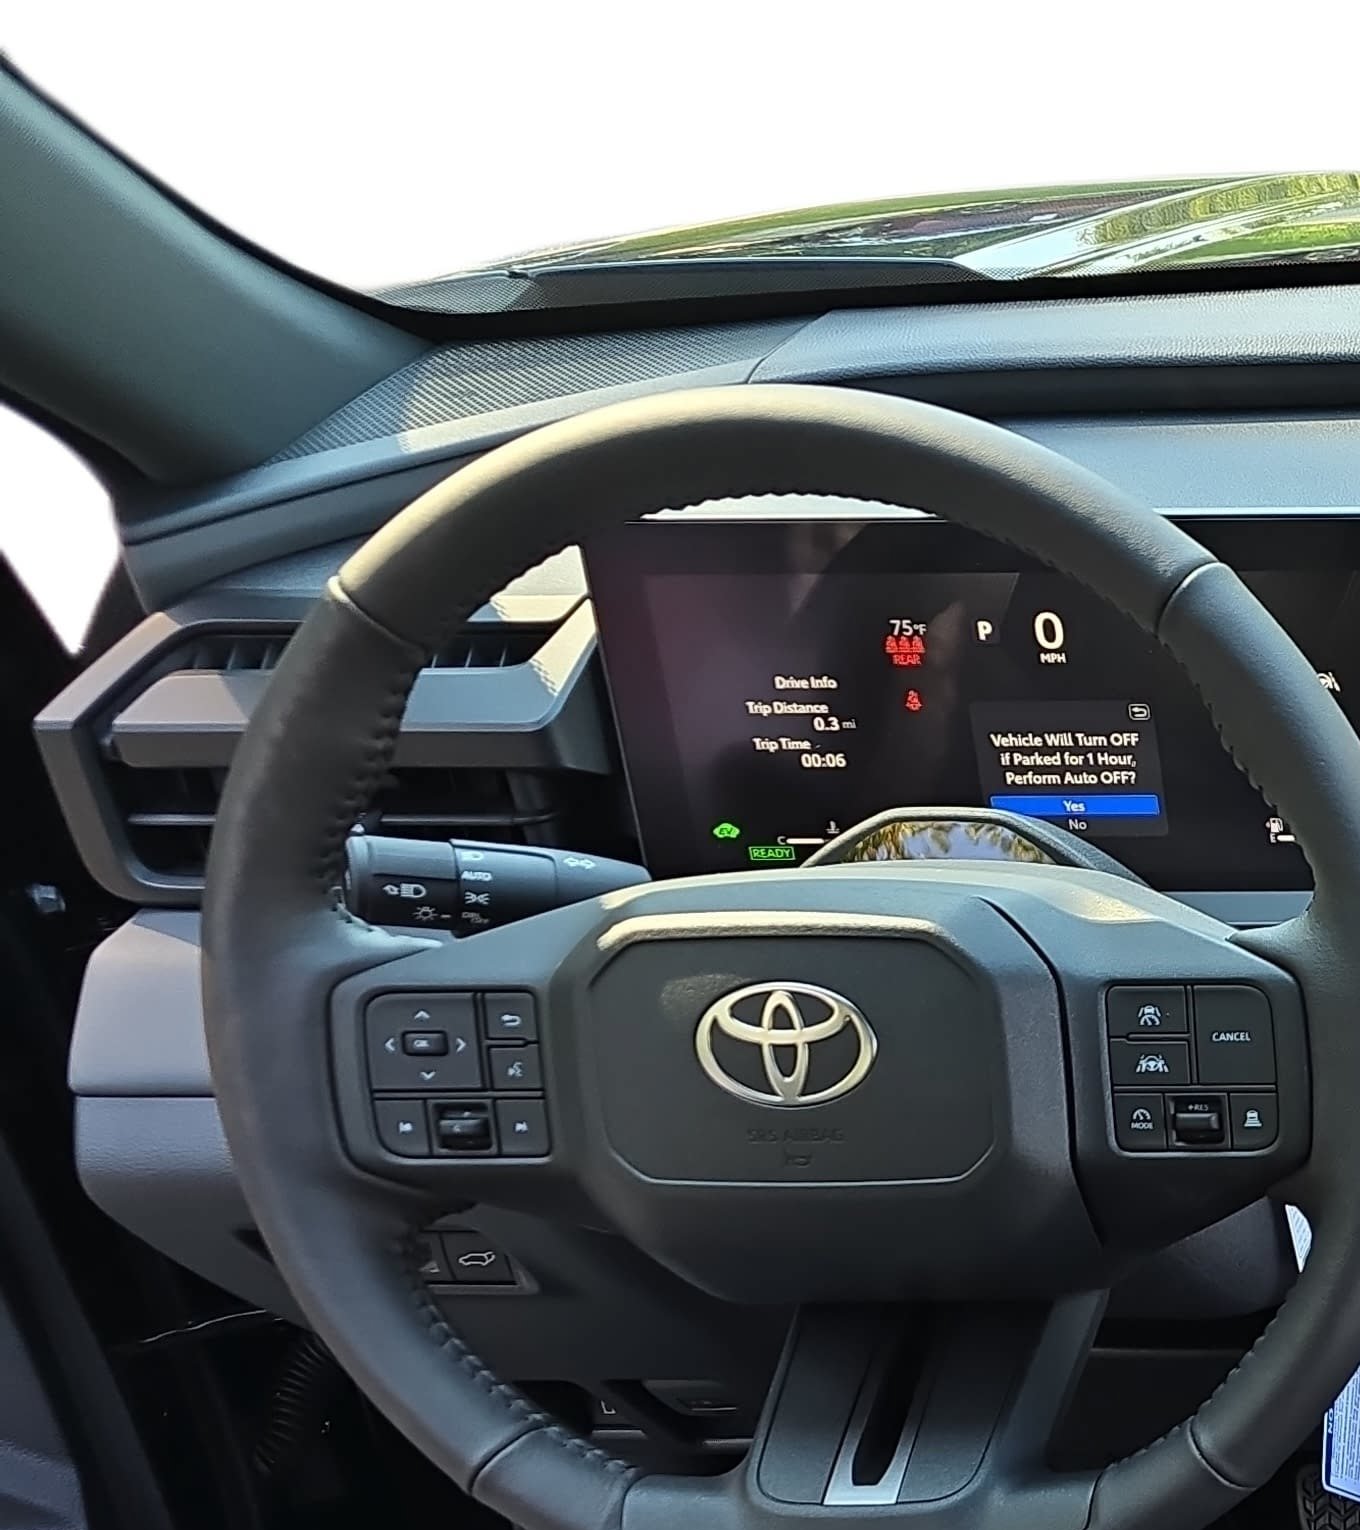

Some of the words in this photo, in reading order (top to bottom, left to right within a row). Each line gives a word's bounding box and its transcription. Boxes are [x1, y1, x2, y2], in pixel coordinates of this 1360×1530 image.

[976, 620, 993, 641] P
[1033, 611, 1064, 650] 0
[893, 654, 922, 665] REAR
[1040, 653, 1067, 664] MPH
[774, 676, 809, 689] Drive
[810, 676, 838, 689] Info
[745, 701, 772, 716] Trip
[773, 701, 829, 714] Distance
[813, 717, 840, 731] 0.3
[842, 719, 857, 729] mi
[753, 738, 780, 752] Trip
[780, 738, 812, 750] Time
[990, 733, 1043, 747] Vehicle
[1044, 733, 1074, 747] Will
[1074, 733, 1108, 747] Turn
[1110, 733, 1139, 746] OFF
[801, 754, 847, 768] 00:06
[1000, 752, 1012, 766] if
[1013, 752, 1061, 766] Parked
[1063, 752, 1085, 766] for
[1086, 753, 1094, 765] 1
[1097, 753, 1137, 767] Hour,
[1005, 772, 1060, 785] Perform
[1063, 772, 1098, 785] Auto
[1100, 771, 1136, 785] OFF?
[1063, 800, 1085, 812] Yes
[1068, 819, 1088, 831] No
[777, 836, 786, 845] C
[1270, 832, 1277, 843] E
[753, 849, 791, 858] READY
[461, 871, 492, 881] AUTO
[1212, 1032, 1252, 1042] CANCEL
[1131, 1122, 1154, 1130] MODE
